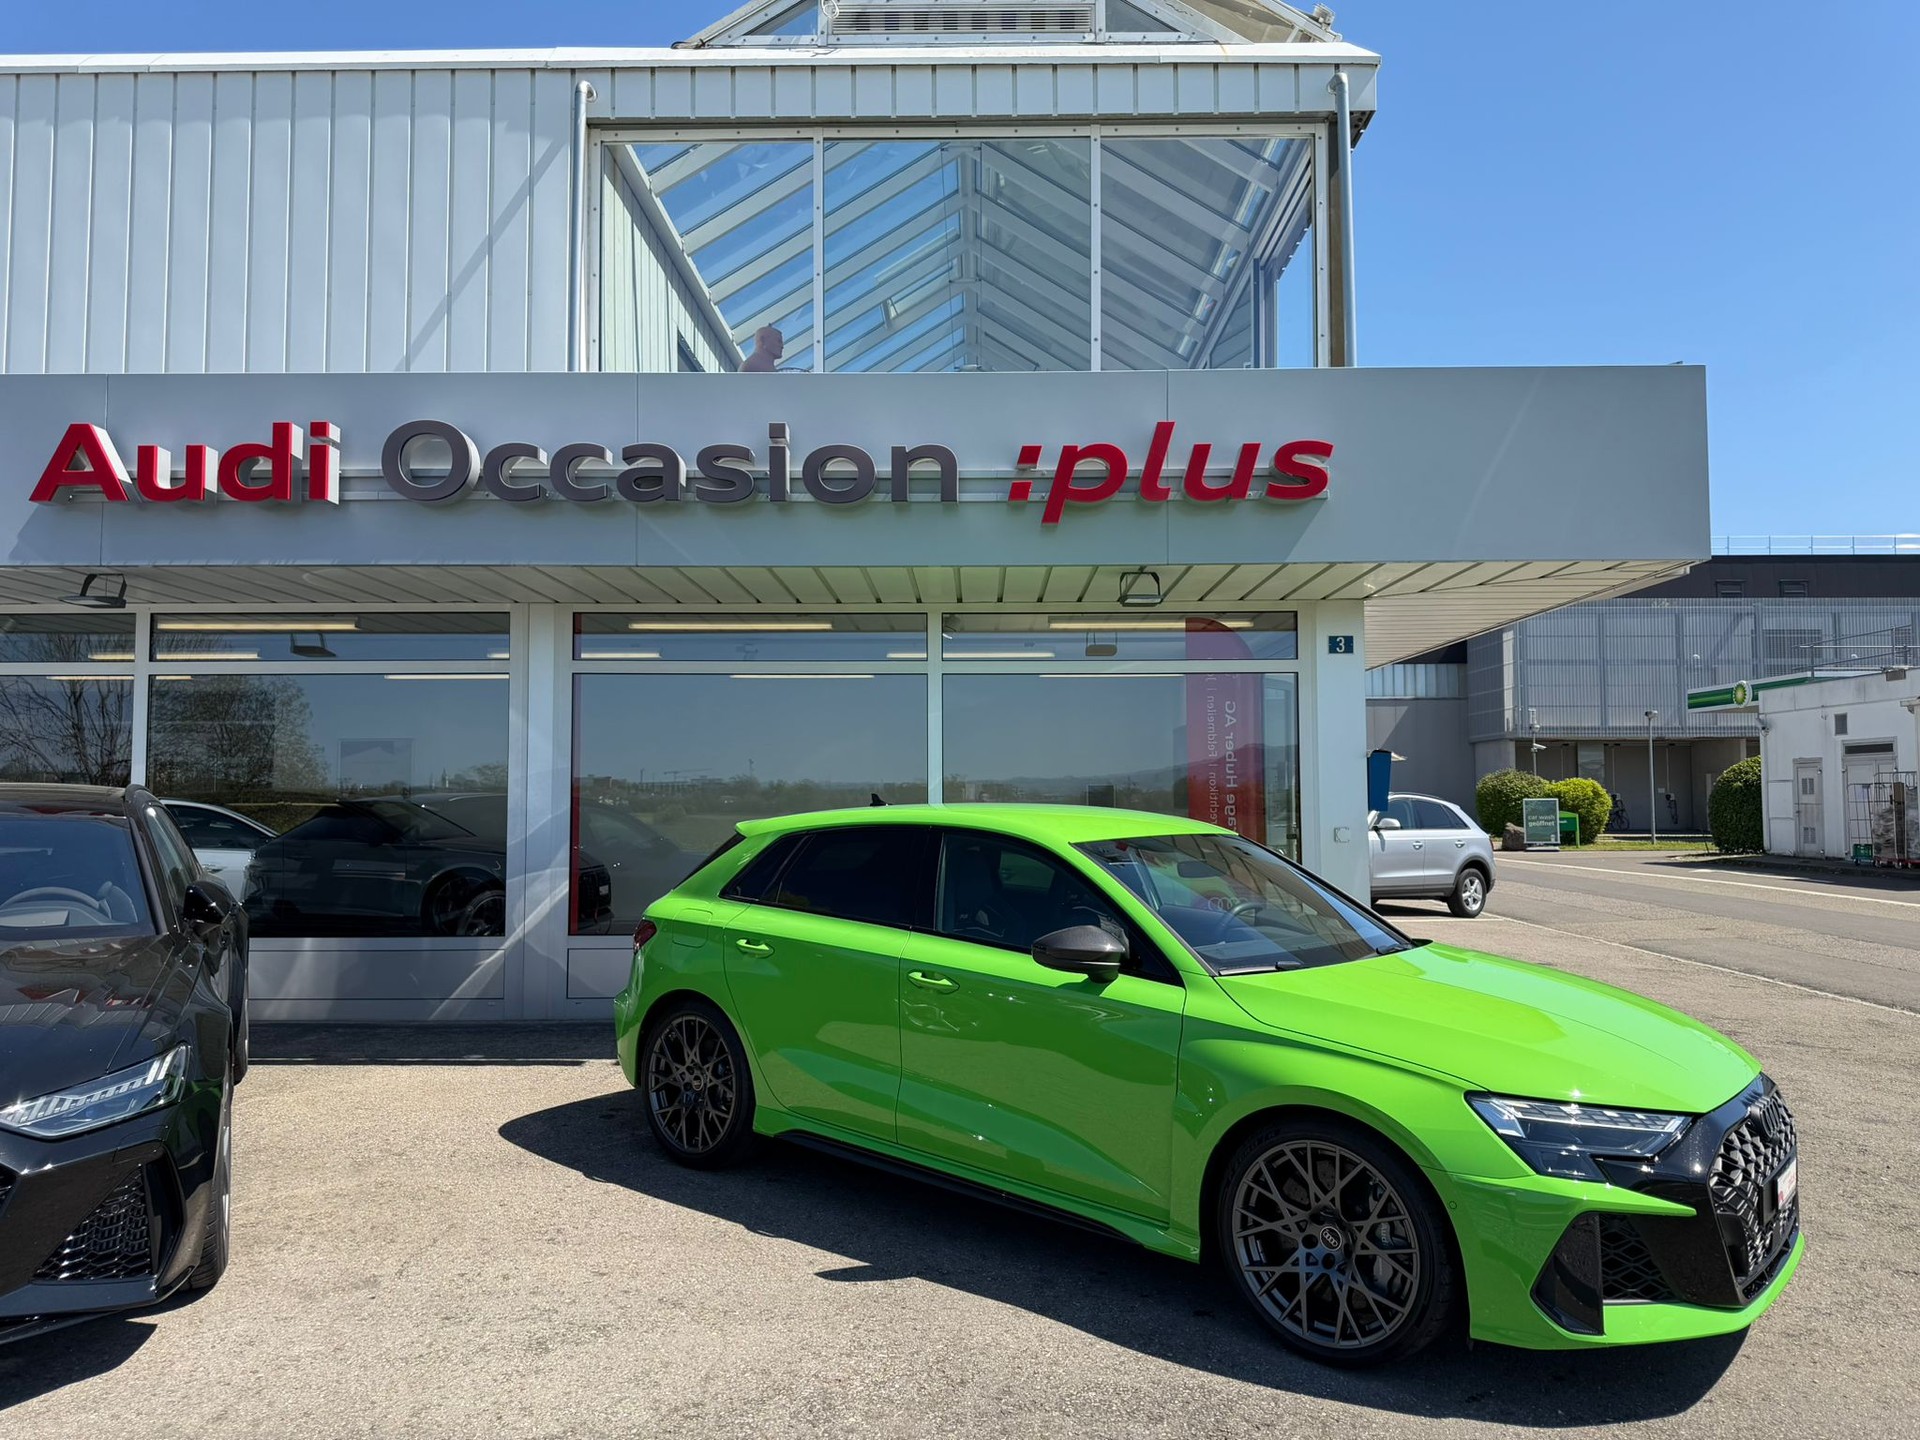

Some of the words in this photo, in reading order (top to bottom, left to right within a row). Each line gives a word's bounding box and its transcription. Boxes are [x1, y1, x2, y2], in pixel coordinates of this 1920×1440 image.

[29, 421, 341, 505] Audi
[381, 419, 960, 505] Occasion
[1336, 636, 1345, 653] 3
